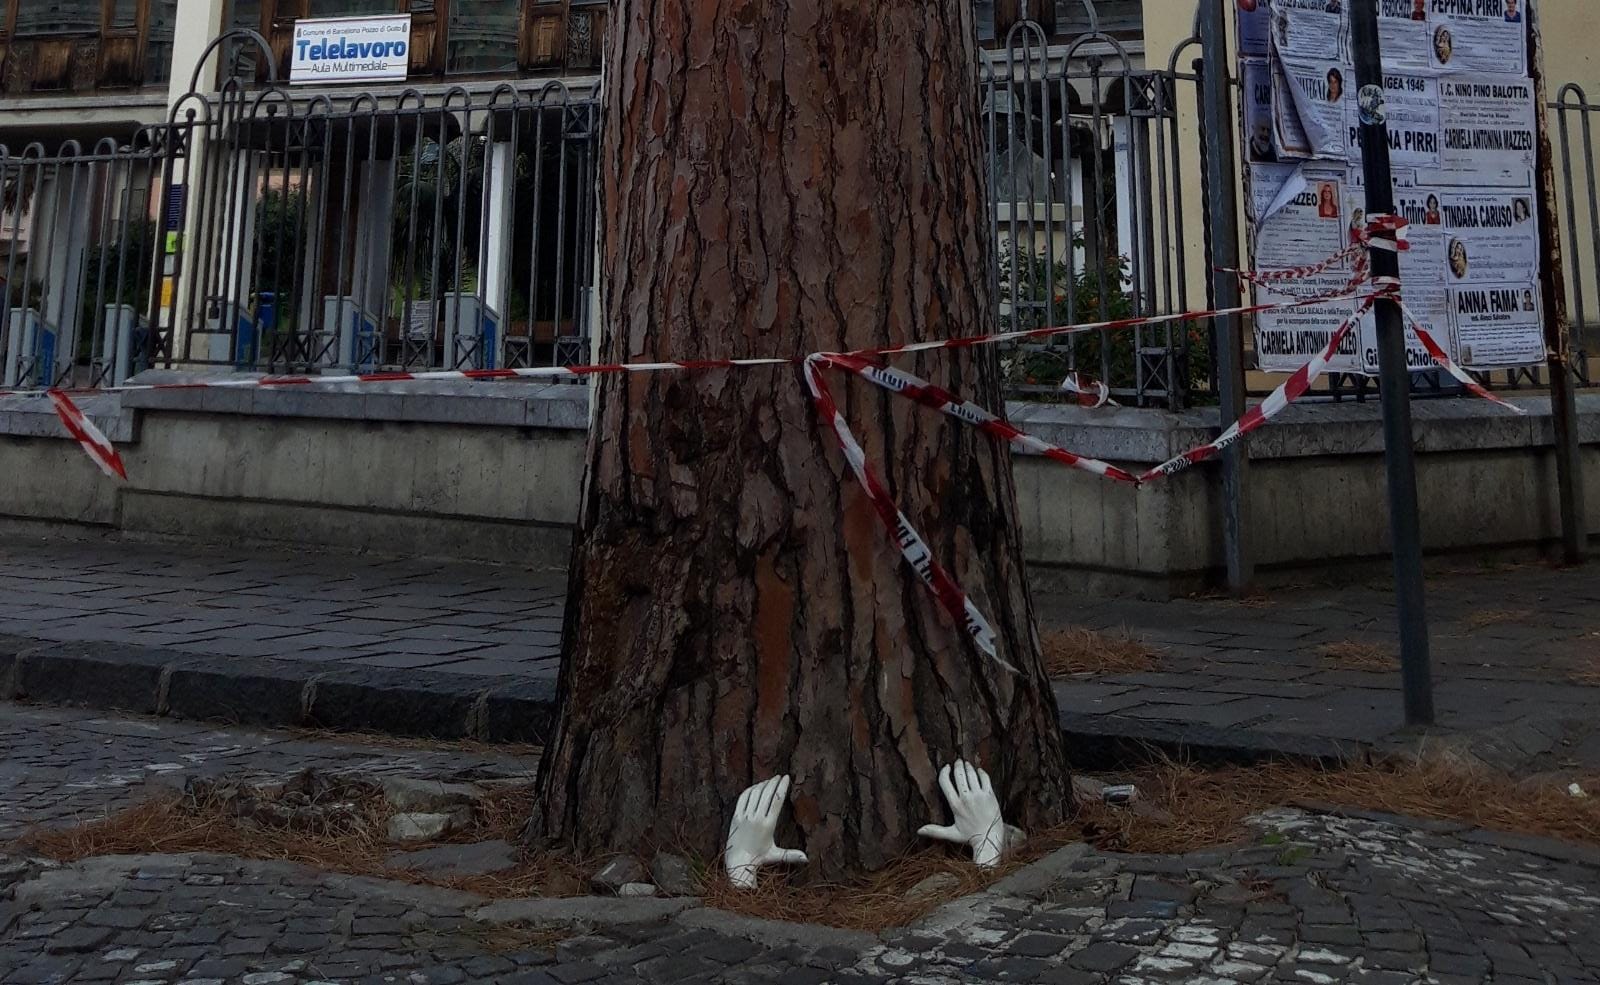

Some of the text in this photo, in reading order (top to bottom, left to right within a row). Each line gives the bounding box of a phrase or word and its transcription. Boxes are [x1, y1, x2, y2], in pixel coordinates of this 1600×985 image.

[1431, 0, 1502, 17] PEPPINA PIRRI
[296, 37, 406, 61] Telelavoro
[311, 60, 388, 73] Aula Multimediale
[1384, 77, 1424, 92] IGEA 1946
[1455, 84, 1472, 98] NINO
[1473, 85, 1491, 98] PINO
[1493, 85, 1529, 100] BALOTTA
[1404, 130, 1437, 153] PIRRI
[1444, 128, 1532, 151] CARMELA ANTONINA MAZZEO
[1443, 205, 1512, 228] TINDARA CARUSO
[1458, 290, 1488, 314] ANNA
[1490, 289, 1519, 313] FAMA'
[1261, 330, 1294, 355] CARMELA
